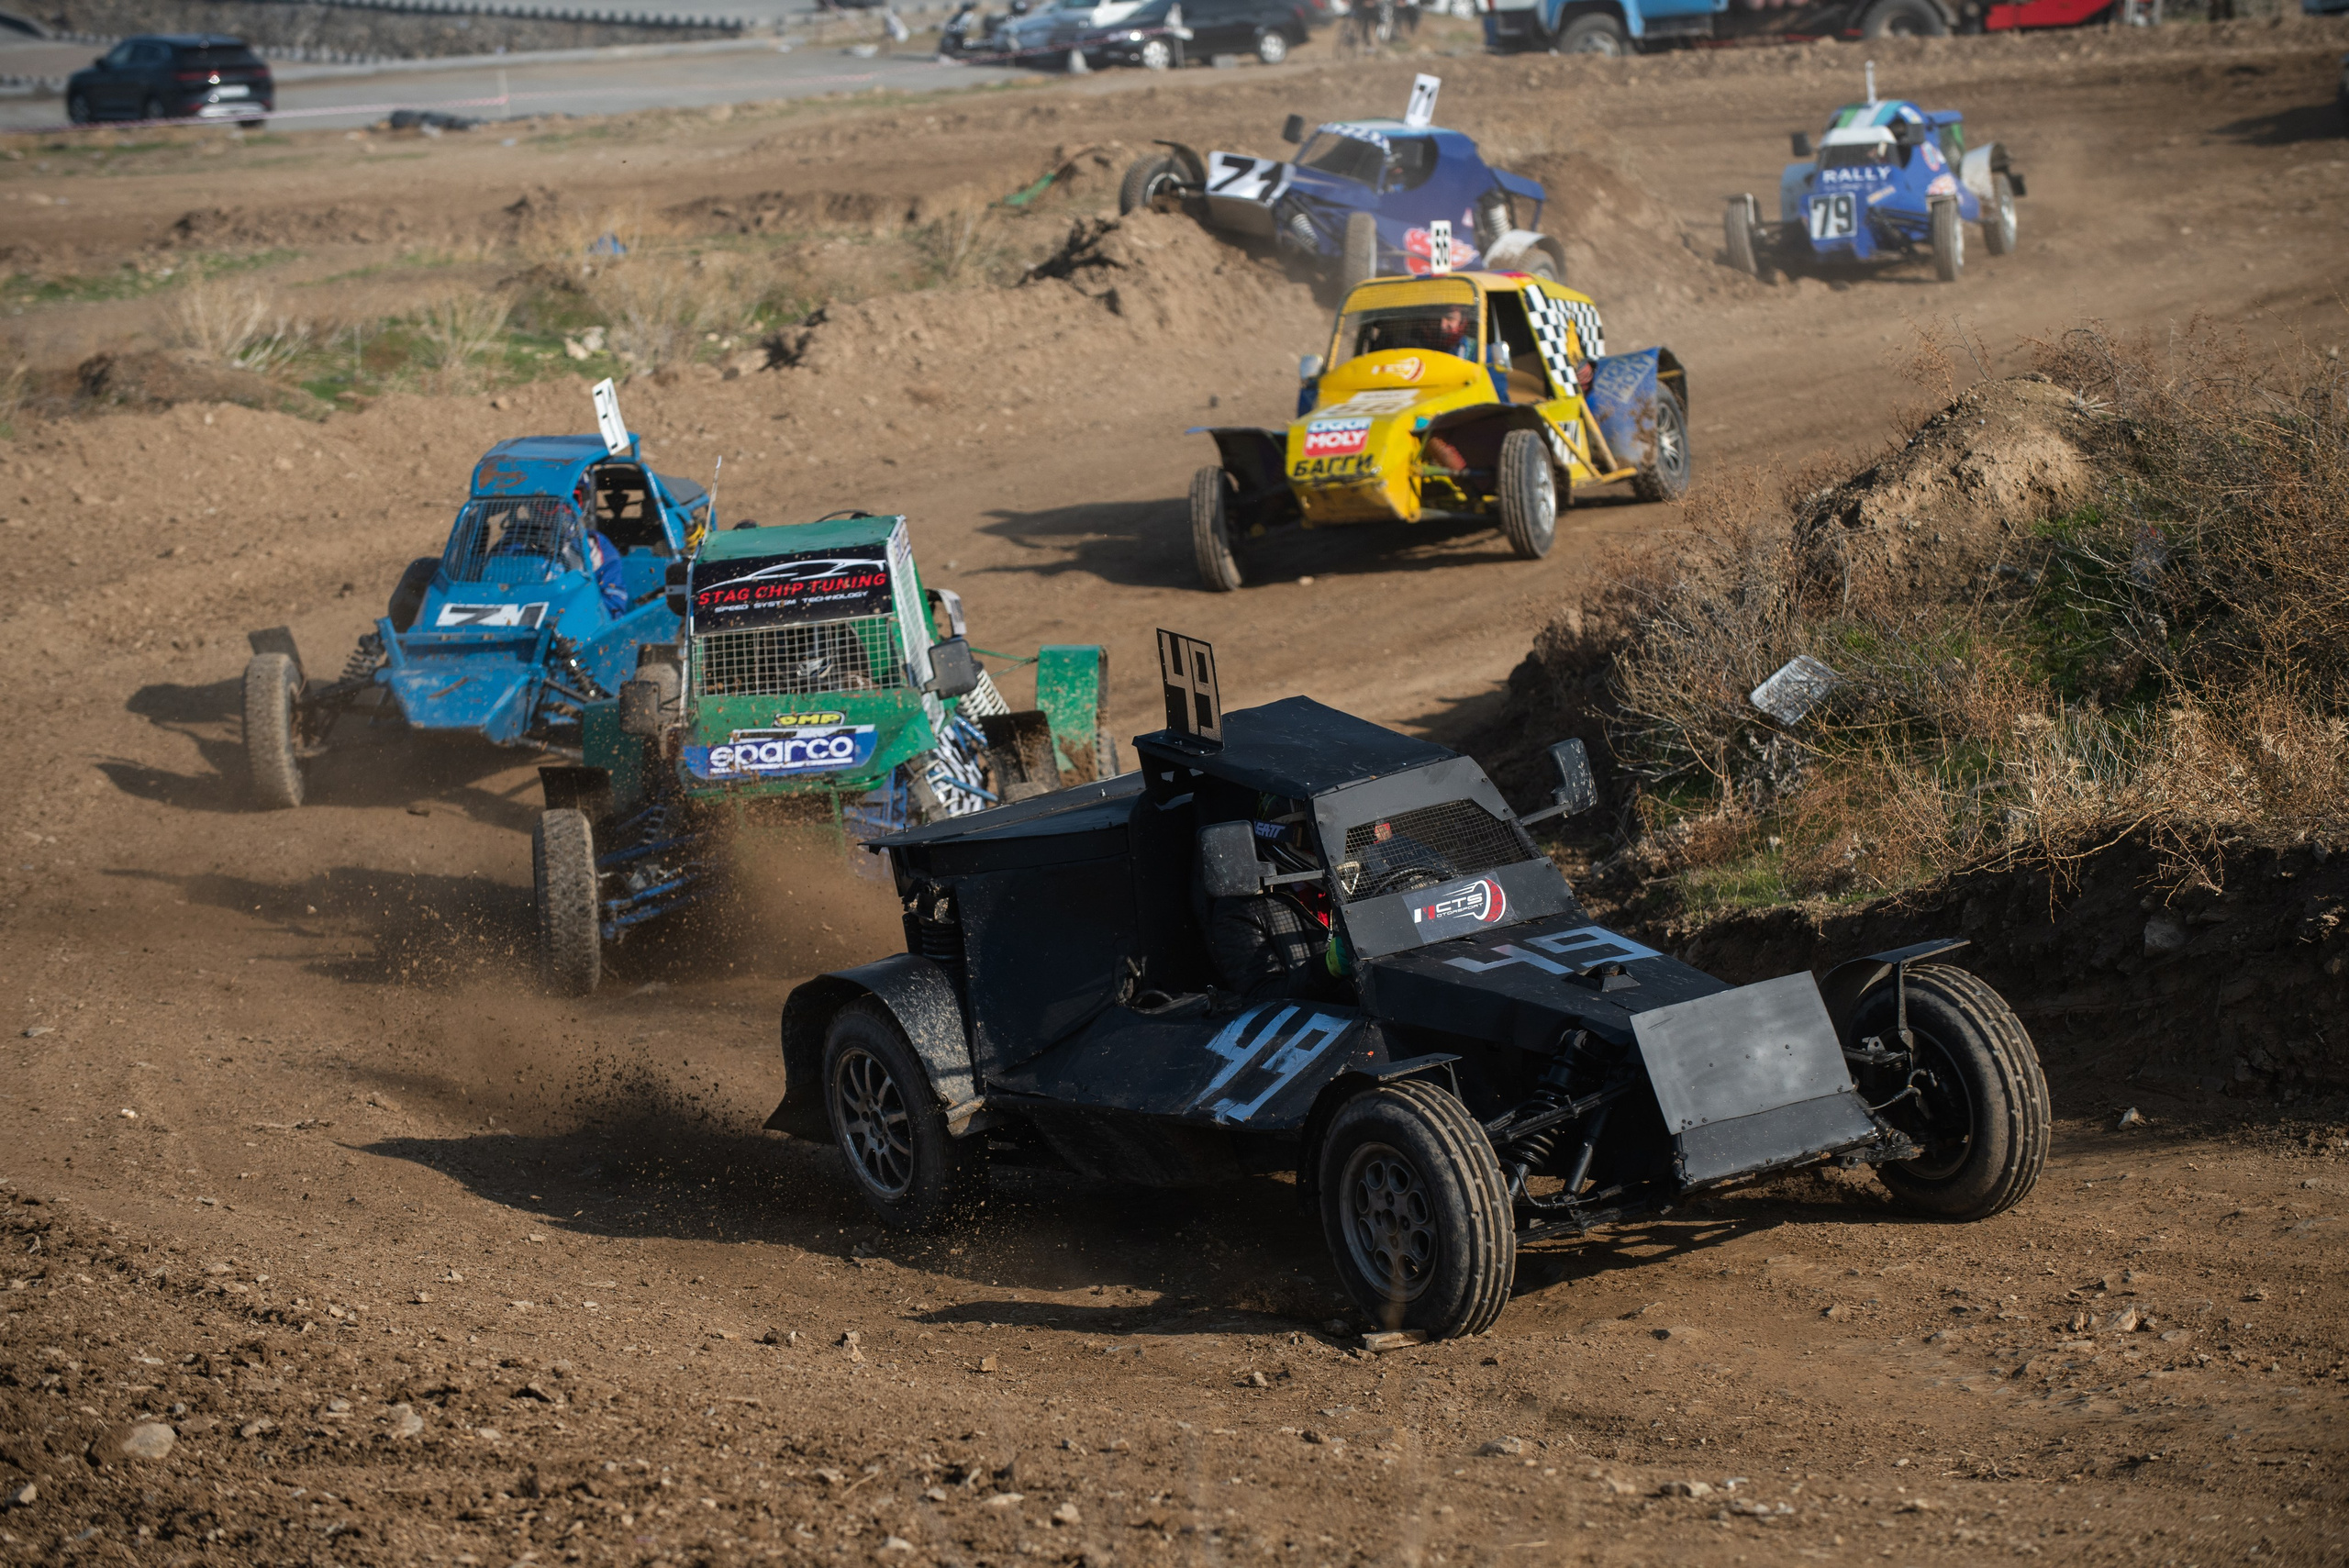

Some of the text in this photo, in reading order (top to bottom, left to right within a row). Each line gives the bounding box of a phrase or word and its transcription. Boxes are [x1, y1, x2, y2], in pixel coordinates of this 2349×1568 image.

[1211, 156, 1283, 202] 71
[1822, 166, 1891, 183] RALLY
[1813, 195, 1853, 237] 79
[1306, 431, 1366, 450] MOLY
[1293, 454, 1375, 476] БАГГИ
[698, 573, 887, 606] STAG CHIP TUNING
[714, 604, 749, 614] SPEED
[801, 590, 870, 604] TECHNOLOGY
[1161, 631, 1223, 742] 49
[778, 713, 841, 725] OMP
[709, 735, 854, 773] sparco
[1442, 925, 1664, 975] 49
[1184, 1002, 1353, 1123] 49
